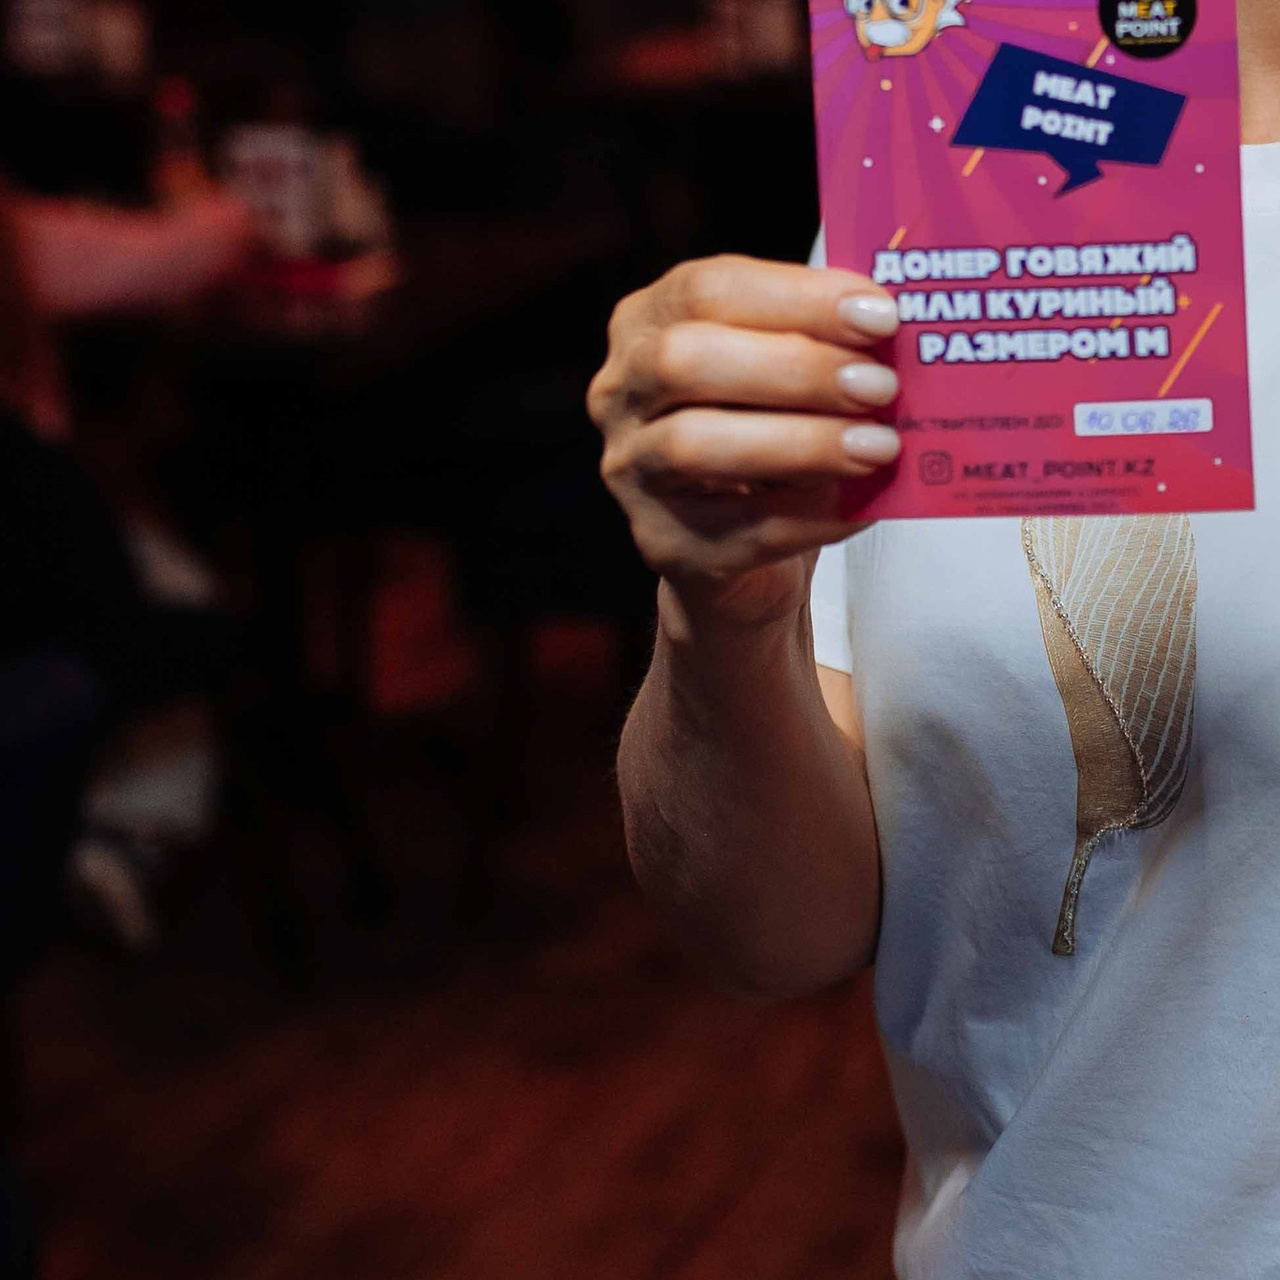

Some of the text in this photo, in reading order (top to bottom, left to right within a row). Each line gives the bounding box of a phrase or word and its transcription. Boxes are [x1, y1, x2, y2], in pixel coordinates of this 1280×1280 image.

[1114, 16, 1182, 38] POINT
[1117, 0, 1177, 19] MEAT
[1032, 70, 1117, 110] MEAT
[1020, 104, 1115, 146] POINT
[872, 234, 1197, 284] ДОНЕР ГОВЯЖИЙ
[898, 276, 1176, 322] ИЛИ КУРИНЫЙ
[918, 325, 1170, 364] РАЗМЕРОМ М
